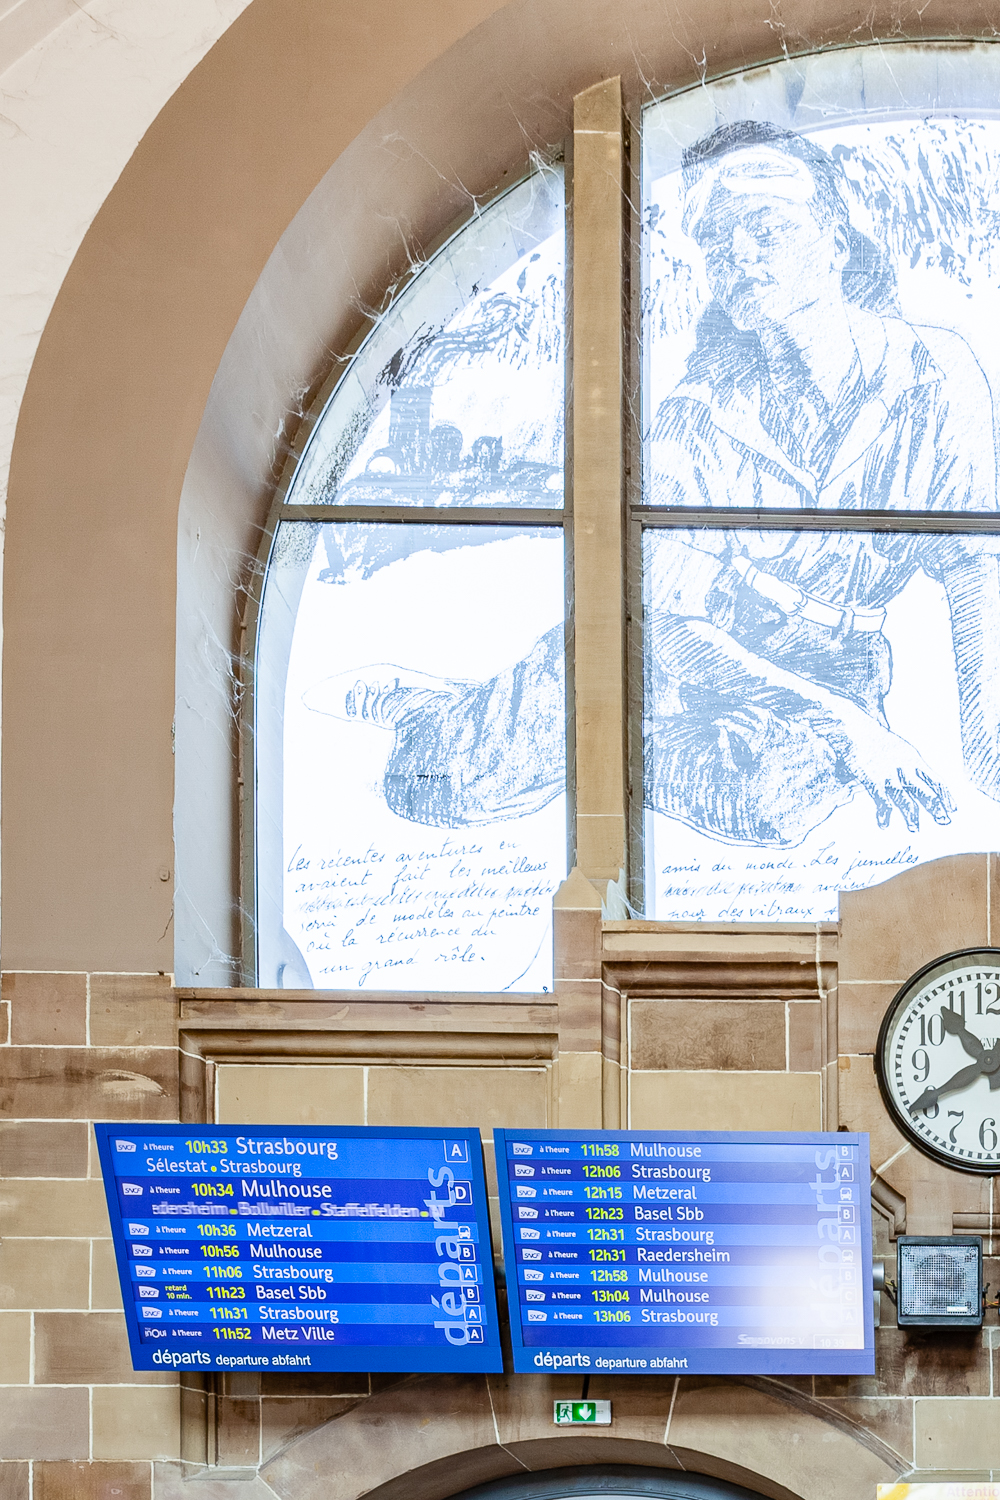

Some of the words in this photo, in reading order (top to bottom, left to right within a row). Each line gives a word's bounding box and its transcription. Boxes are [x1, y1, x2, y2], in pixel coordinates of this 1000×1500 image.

[918, 1014, 946, 1046] 10
[912, 1049, 930, 1082] 9
[948, 1110, 964, 1143] 7
[979, 1118, 998, 1151] 6
[185, 1140, 228, 1154] 10h33
[236, 1137, 338, 1159] Strasbourg
[451, 1145, 462, 1157] A
[581, 1144, 619, 1157] 11h58
[630, 1143, 701, 1158] Mulhouse
[146, 1158, 208, 1173] Sélestat
[220, 1159, 302, 1177] Strasbourg
[582, 1165, 621, 1178] 12h06
[632, 1164, 711, 1182] Strasbourg
[192, 1183, 234, 1197] 10h34
[242, 1180, 332, 1198] Mulhouse
[584, 1187, 622, 1199] 12h15
[633, 1186, 697, 1200] Metzeral
[585, 1208, 624, 1220] 12h23
[634, 1207, 673, 1221] Basel
[677, 1207, 704, 1221] Sbb
[197, 1224, 236, 1237] 10h36
[247, 1223, 313, 1238] Metzeral
[587, 1228, 625, 1241] 12h31
[636, 1228, 714, 1245] Strasbourg
[201, 1244, 239, 1258] 10h56
[250, 1244, 322, 1258] Mulhouse
[423, 1165, 470, 1346] départs
[588, 1249, 626, 1262] 12h31
[637, 1248, 730, 1262] Raedersheim
[203, 1266, 242, 1279] 11h06
[253, 1265, 333, 1282] Strasbourg
[590, 1270, 628, 1282] 12h58
[638, 1269, 708, 1282] Mulhouse
[207, 1287, 246, 1299] 11h23
[257, 1286, 295, 1299] Basel
[299, 1286, 327, 1300] Sbb
[592, 1290, 629, 1302] 13h04
[640, 1289, 709, 1303] Mulhouse
[209, 1307, 248, 1320] 11h31
[259, 1306, 339, 1323] Strasbourg
[593, 1311, 631, 1322] 13h06
[641, 1309, 718, 1326] Strasbourg
[213, 1328, 251, 1341] 11h52
[262, 1327, 298, 1341] Metz
[301, 1327, 334, 1341] Ville
[152, 1351, 211, 1367] départs
[216, 1355, 269, 1367] departure
[272, 1354, 311, 1367] abfahrt
[534, 1353, 590, 1367] départs
[595, 1357, 647, 1369] departure
[650, 1357, 688, 1368] abfahrt
